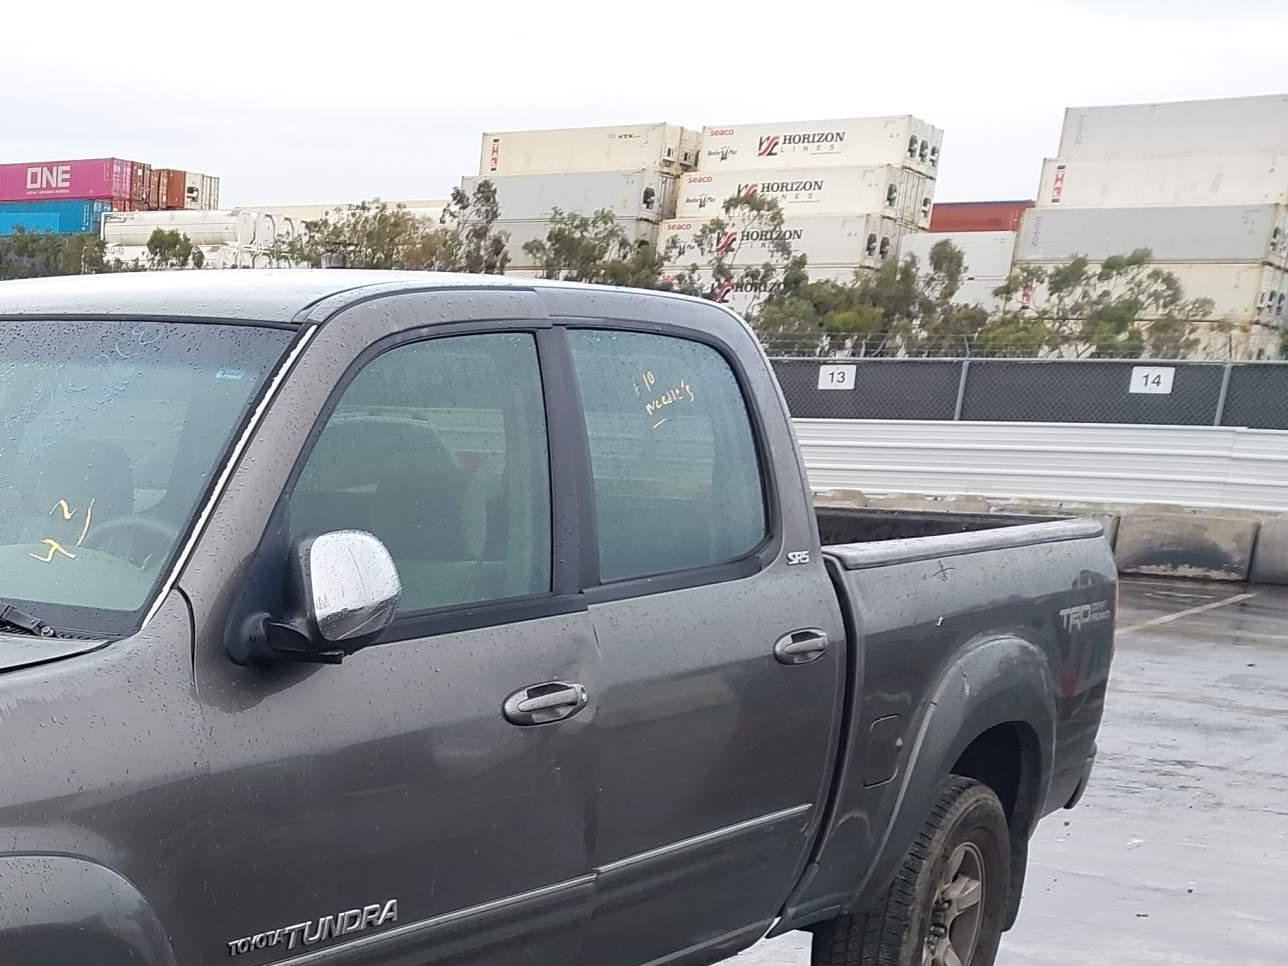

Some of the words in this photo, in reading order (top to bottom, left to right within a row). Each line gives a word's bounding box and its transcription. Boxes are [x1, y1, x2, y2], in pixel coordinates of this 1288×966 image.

[710, 128, 735, 137] seaco
[782, 131, 846, 145] HORIZON
[779, 143, 836, 153] LINES
[26, 165, 71, 189] ONE
[687, 175, 713, 184] seaco
[761, 180, 824, 193] HORIZON
[666, 223, 692, 231] seaco
[740, 229, 803, 241] HORIZON
[828, 371, 846, 384] 13
[1141, 373, 1163, 388] 14
[787, 551, 809, 566] SR5
[1060, 603, 1091, 633] TRD
[227, 928, 285, 956] TOYOTA
[283, 898, 398, 951] TUNDRA
